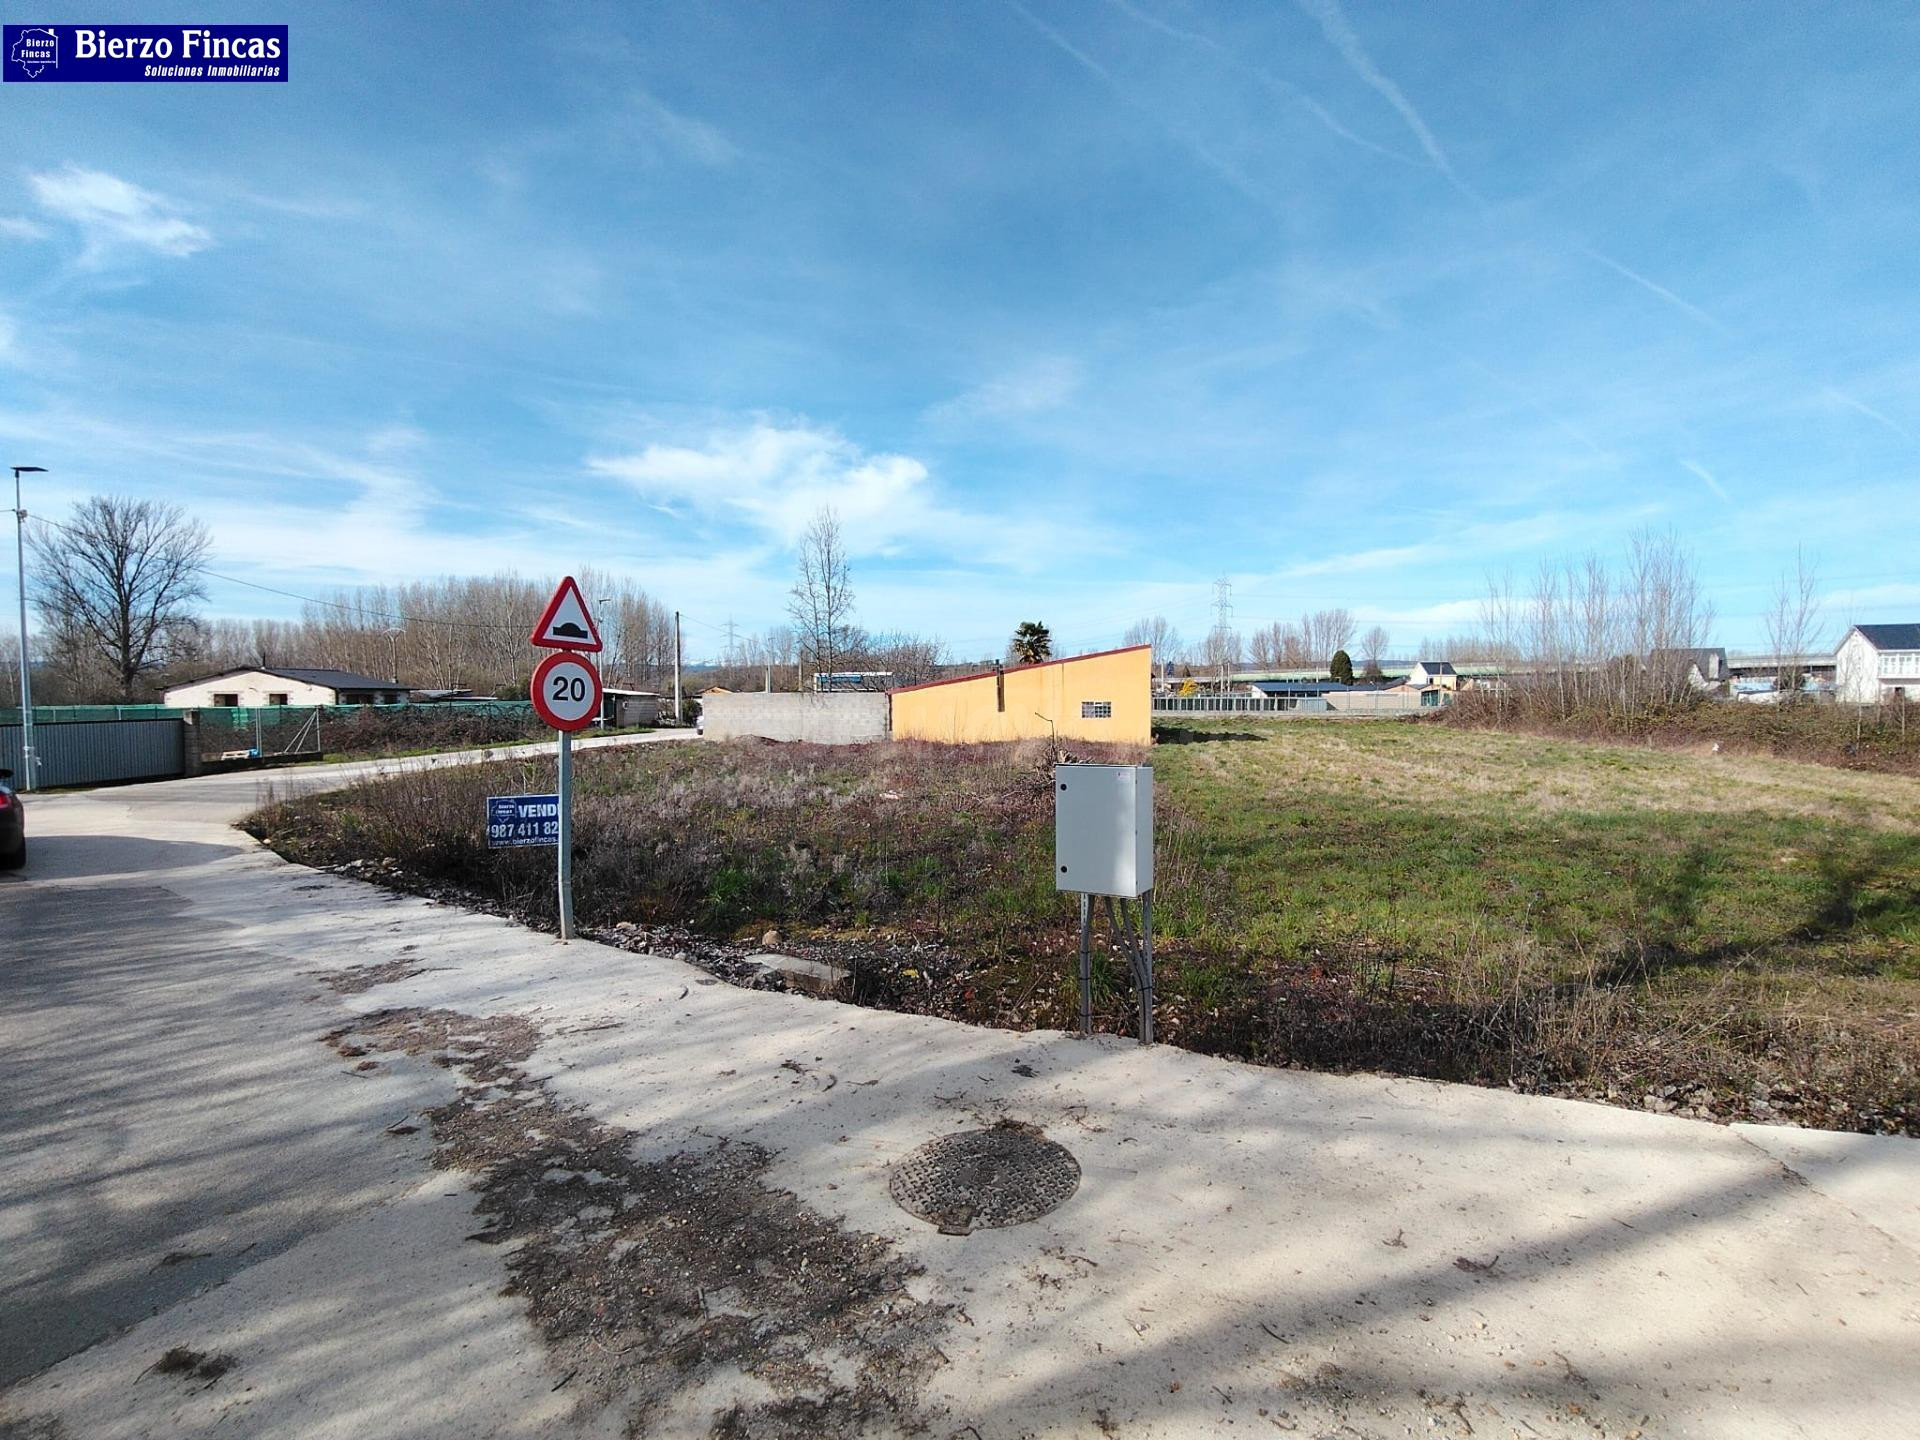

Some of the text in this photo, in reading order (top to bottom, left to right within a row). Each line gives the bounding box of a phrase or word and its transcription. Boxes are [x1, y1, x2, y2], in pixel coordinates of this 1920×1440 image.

[552, 676, 586, 702] 20
[518, 803, 560, 818] VEND
[491, 820, 559, 838] 987 411 82
